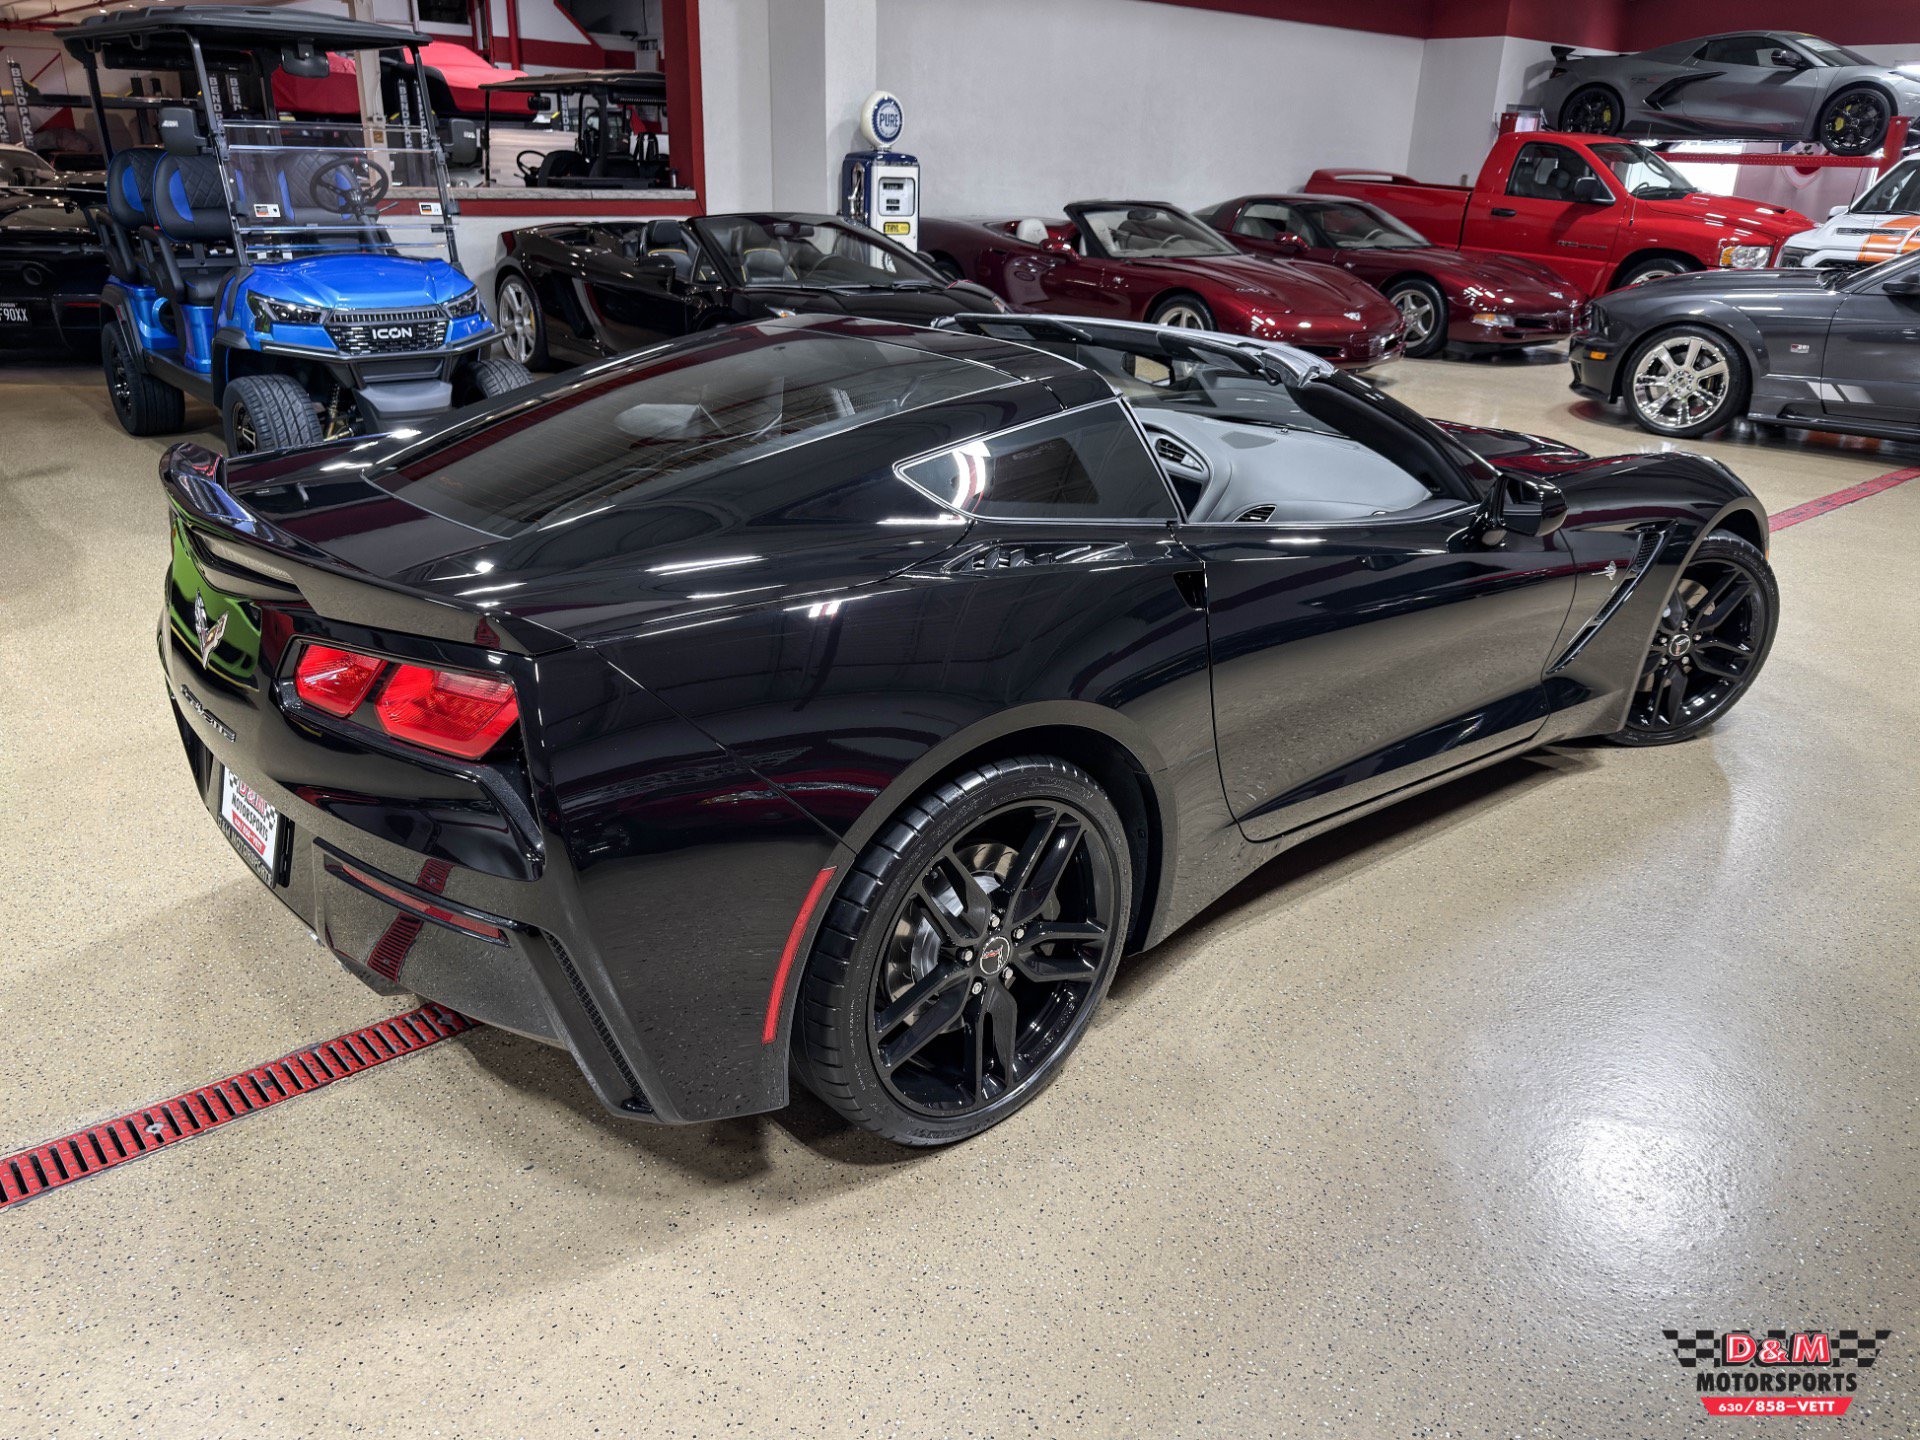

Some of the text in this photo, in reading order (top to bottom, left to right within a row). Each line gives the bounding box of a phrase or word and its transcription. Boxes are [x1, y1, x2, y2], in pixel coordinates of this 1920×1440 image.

[11, 68, 33, 134] BENDPAK
[880, 113, 898, 127] PURE
[372, 327, 413, 339] ICON
[231, 793, 268, 842] MOTORSPORTS
